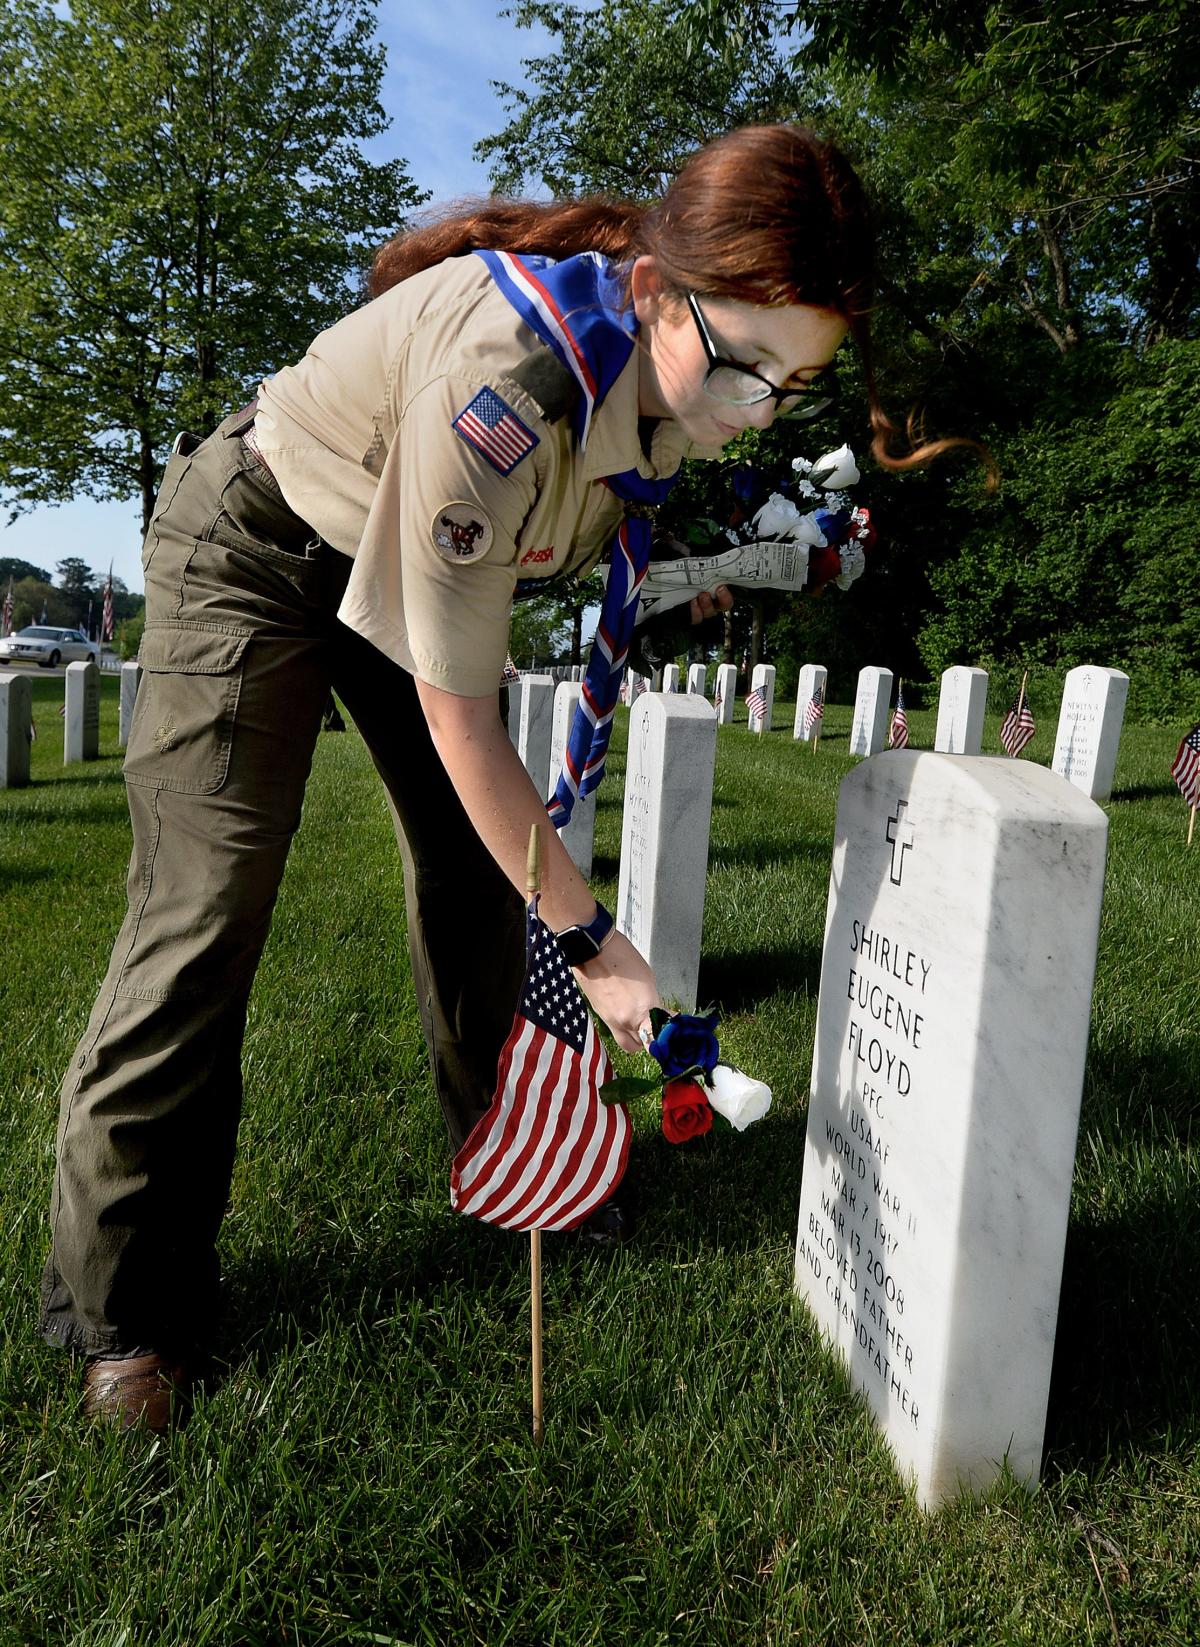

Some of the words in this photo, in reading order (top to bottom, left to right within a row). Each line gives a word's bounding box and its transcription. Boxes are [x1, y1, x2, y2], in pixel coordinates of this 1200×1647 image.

[850, 919, 932, 995] SHIRLEY
[847, 968, 924, 1049] EUGENE
[848, 1021, 911, 1096] FLOYD
[851, 1110, 890, 1165] USAAF
[862, 1082, 884, 1119] PFC
[825, 1120, 866, 1179] WORLD
[873, 1171, 900, 1217] WAR
[831, 1165, 857, 1212] MAR
[862, 1202, 869, 1223] 7
[820, 1192, 845, 1238] MAR
[850, 1229, 861, 1257] 13
[866, 1250, 905, 1315] 2008
[809, 1212, 858, 1292] BELOVED
[863, 1287, 913, 1374] FATHER
[799, 1239, 822, 1279] AND
[825, 1275, 919, 1431] GRANDFATHER
